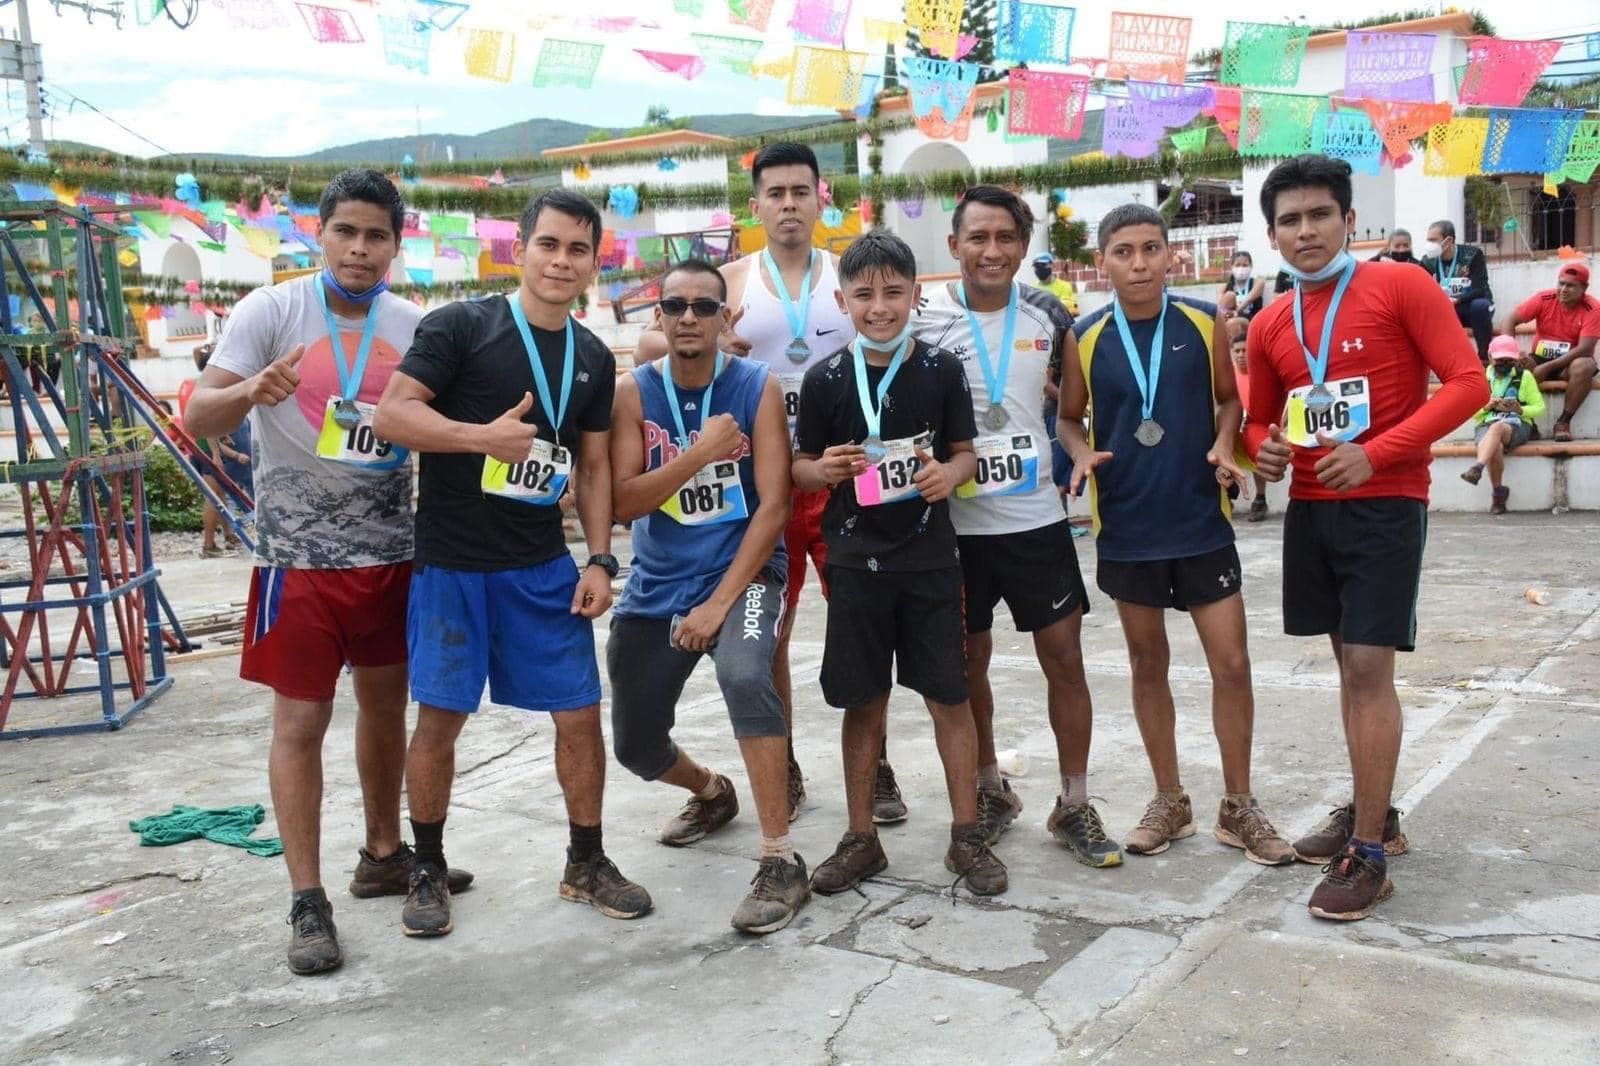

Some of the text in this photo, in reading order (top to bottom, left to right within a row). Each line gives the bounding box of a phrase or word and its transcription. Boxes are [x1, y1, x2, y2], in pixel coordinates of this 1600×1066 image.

[1304, 401, 1350, 435] 046
[506, 460, 556, 492] 082
[877, 456, 921, 490] 132
[975, 453, 1023, 485] 050
[680, 483, 724, 515] 087
[743, 582, 766, 640] Reebok
